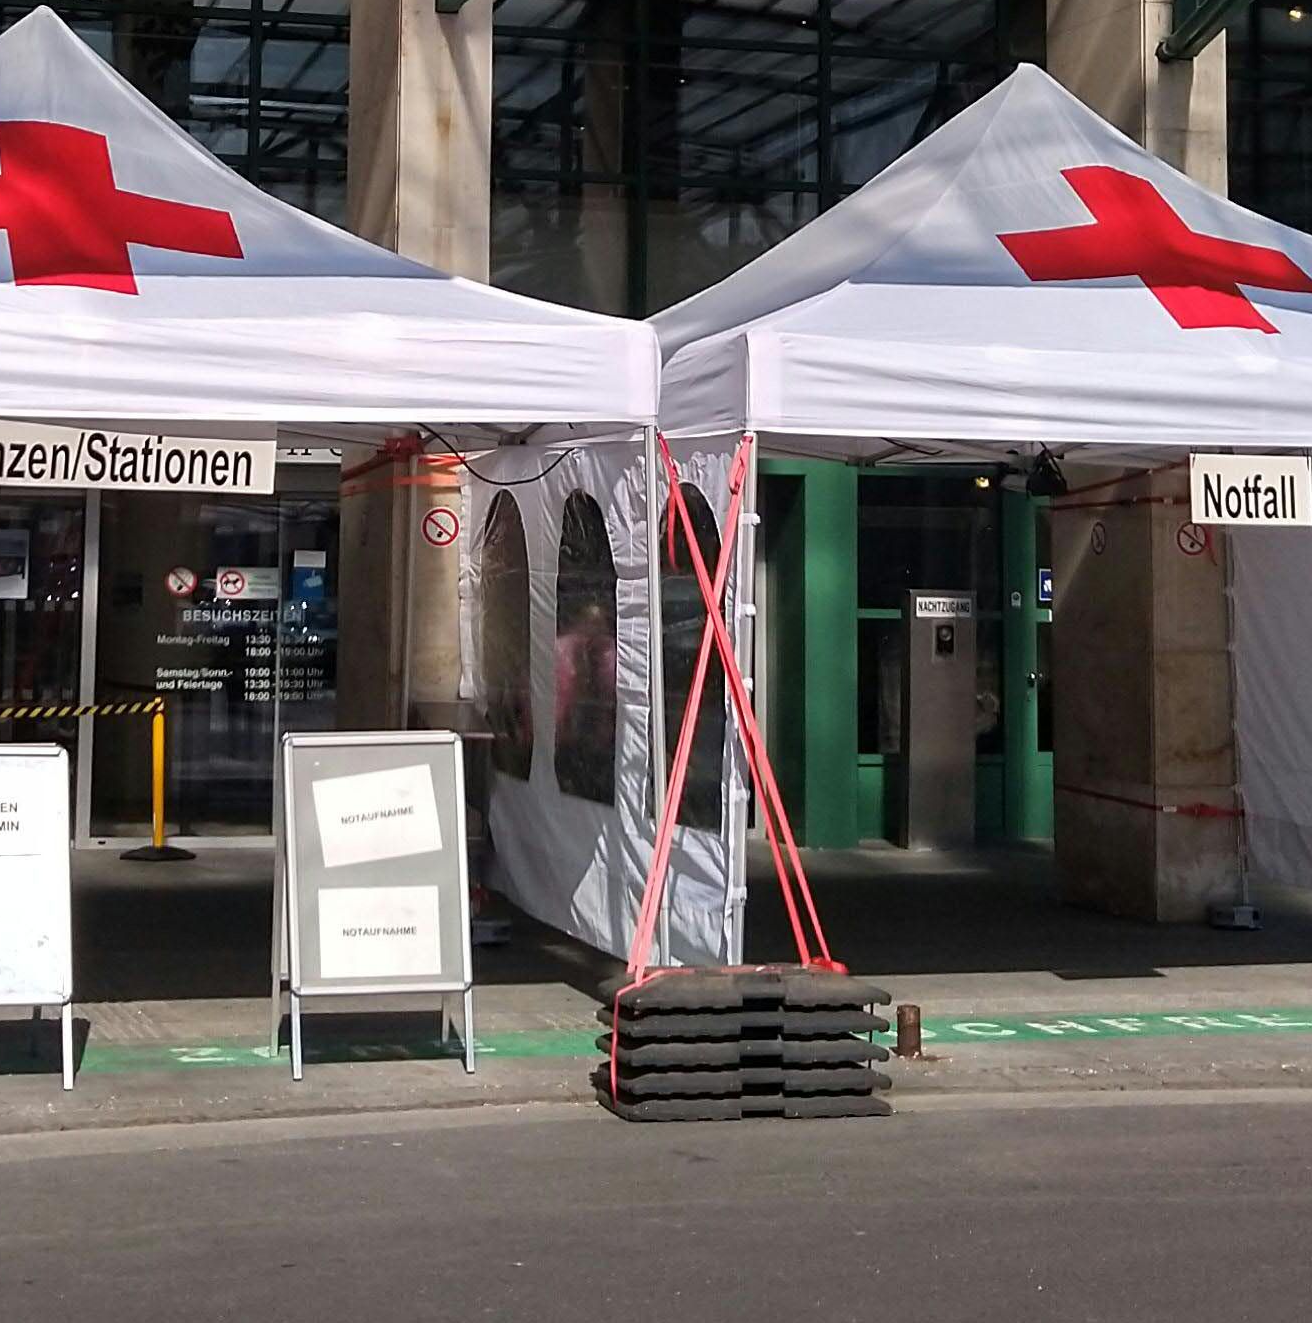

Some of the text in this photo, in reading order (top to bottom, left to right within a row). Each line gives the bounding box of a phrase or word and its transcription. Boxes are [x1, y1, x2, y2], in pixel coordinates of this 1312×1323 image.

[1203, 473, 1296, 519] Notfall
[918, 600, 970, 613] NACHTZUGANG
[183, 609, 302, 622] BESUCHSZEITEN
[340, 805, 415, 825] NOTAUFNAHME
[342, 926, 417, 938] NOTAUFNAHME
